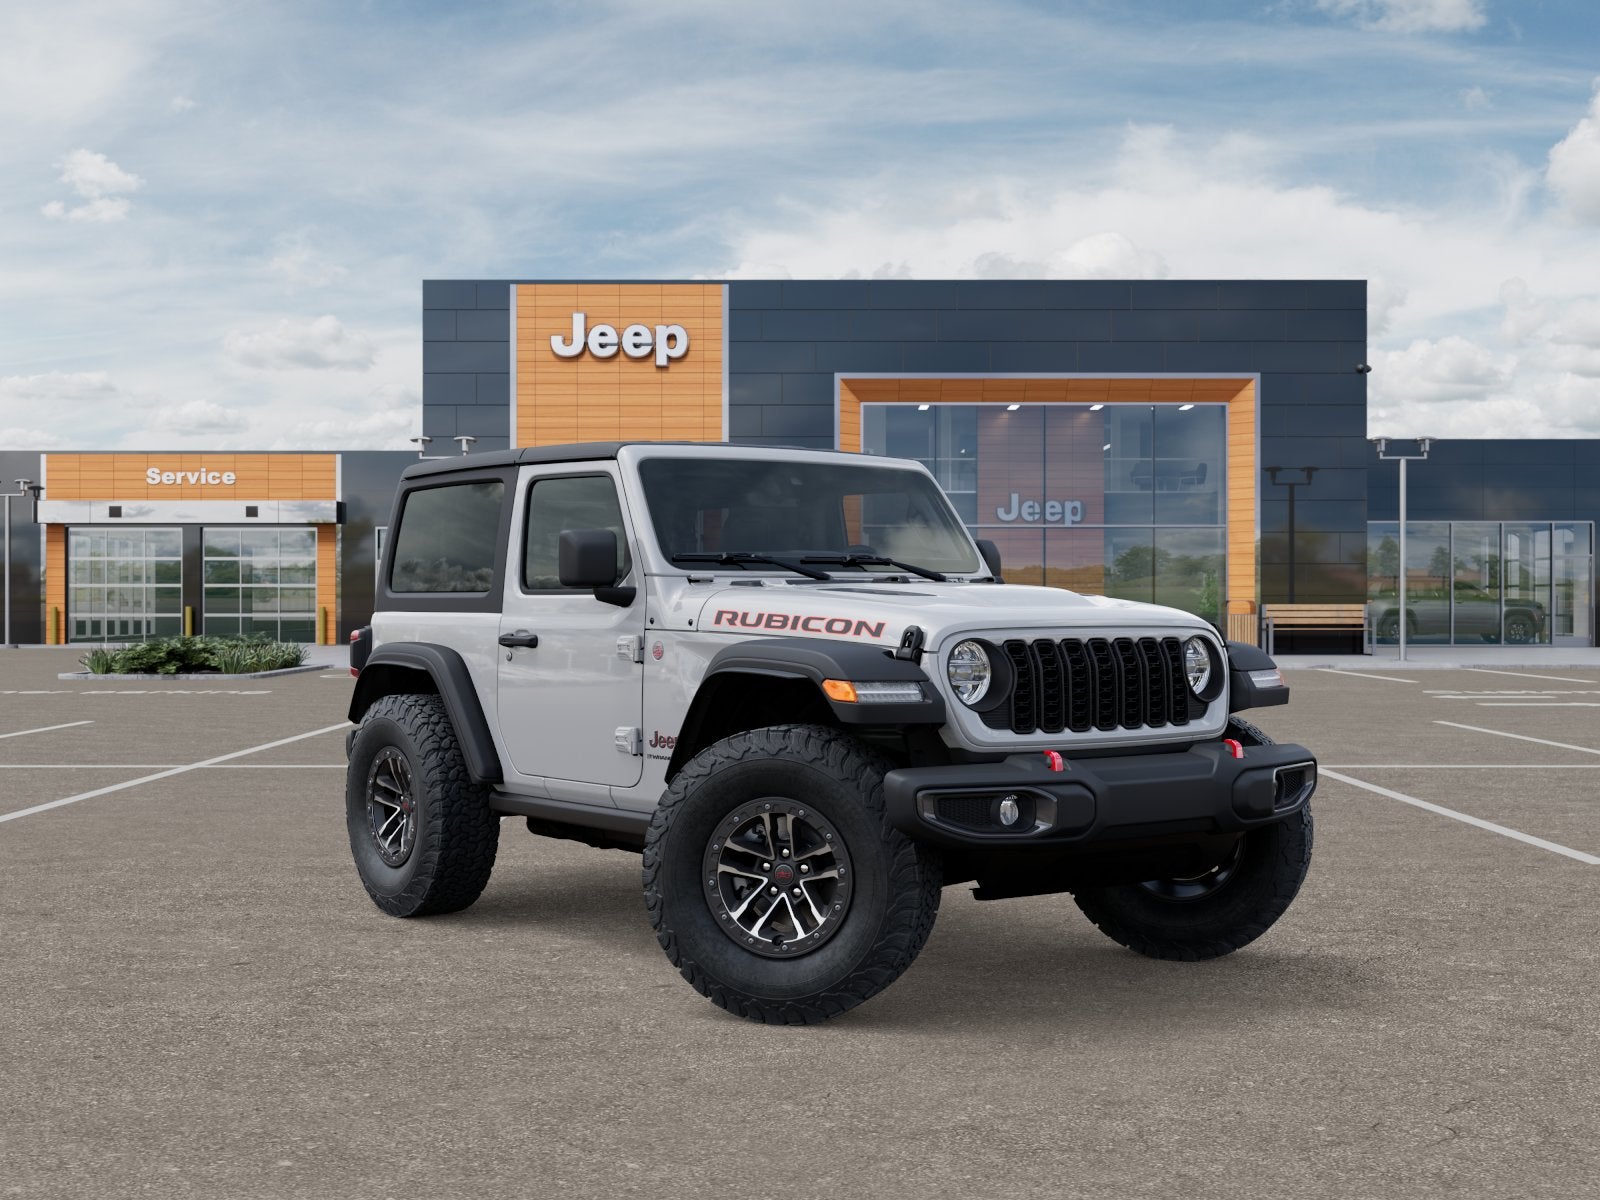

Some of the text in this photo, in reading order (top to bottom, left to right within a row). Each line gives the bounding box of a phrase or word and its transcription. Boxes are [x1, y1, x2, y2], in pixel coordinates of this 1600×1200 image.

[550, 312, 689, 367] Jeep
[146, 467, 236, 485] Service
[996, 493, 1084, 527] Jeep
[714, 610, 886, 638] RUBICON
